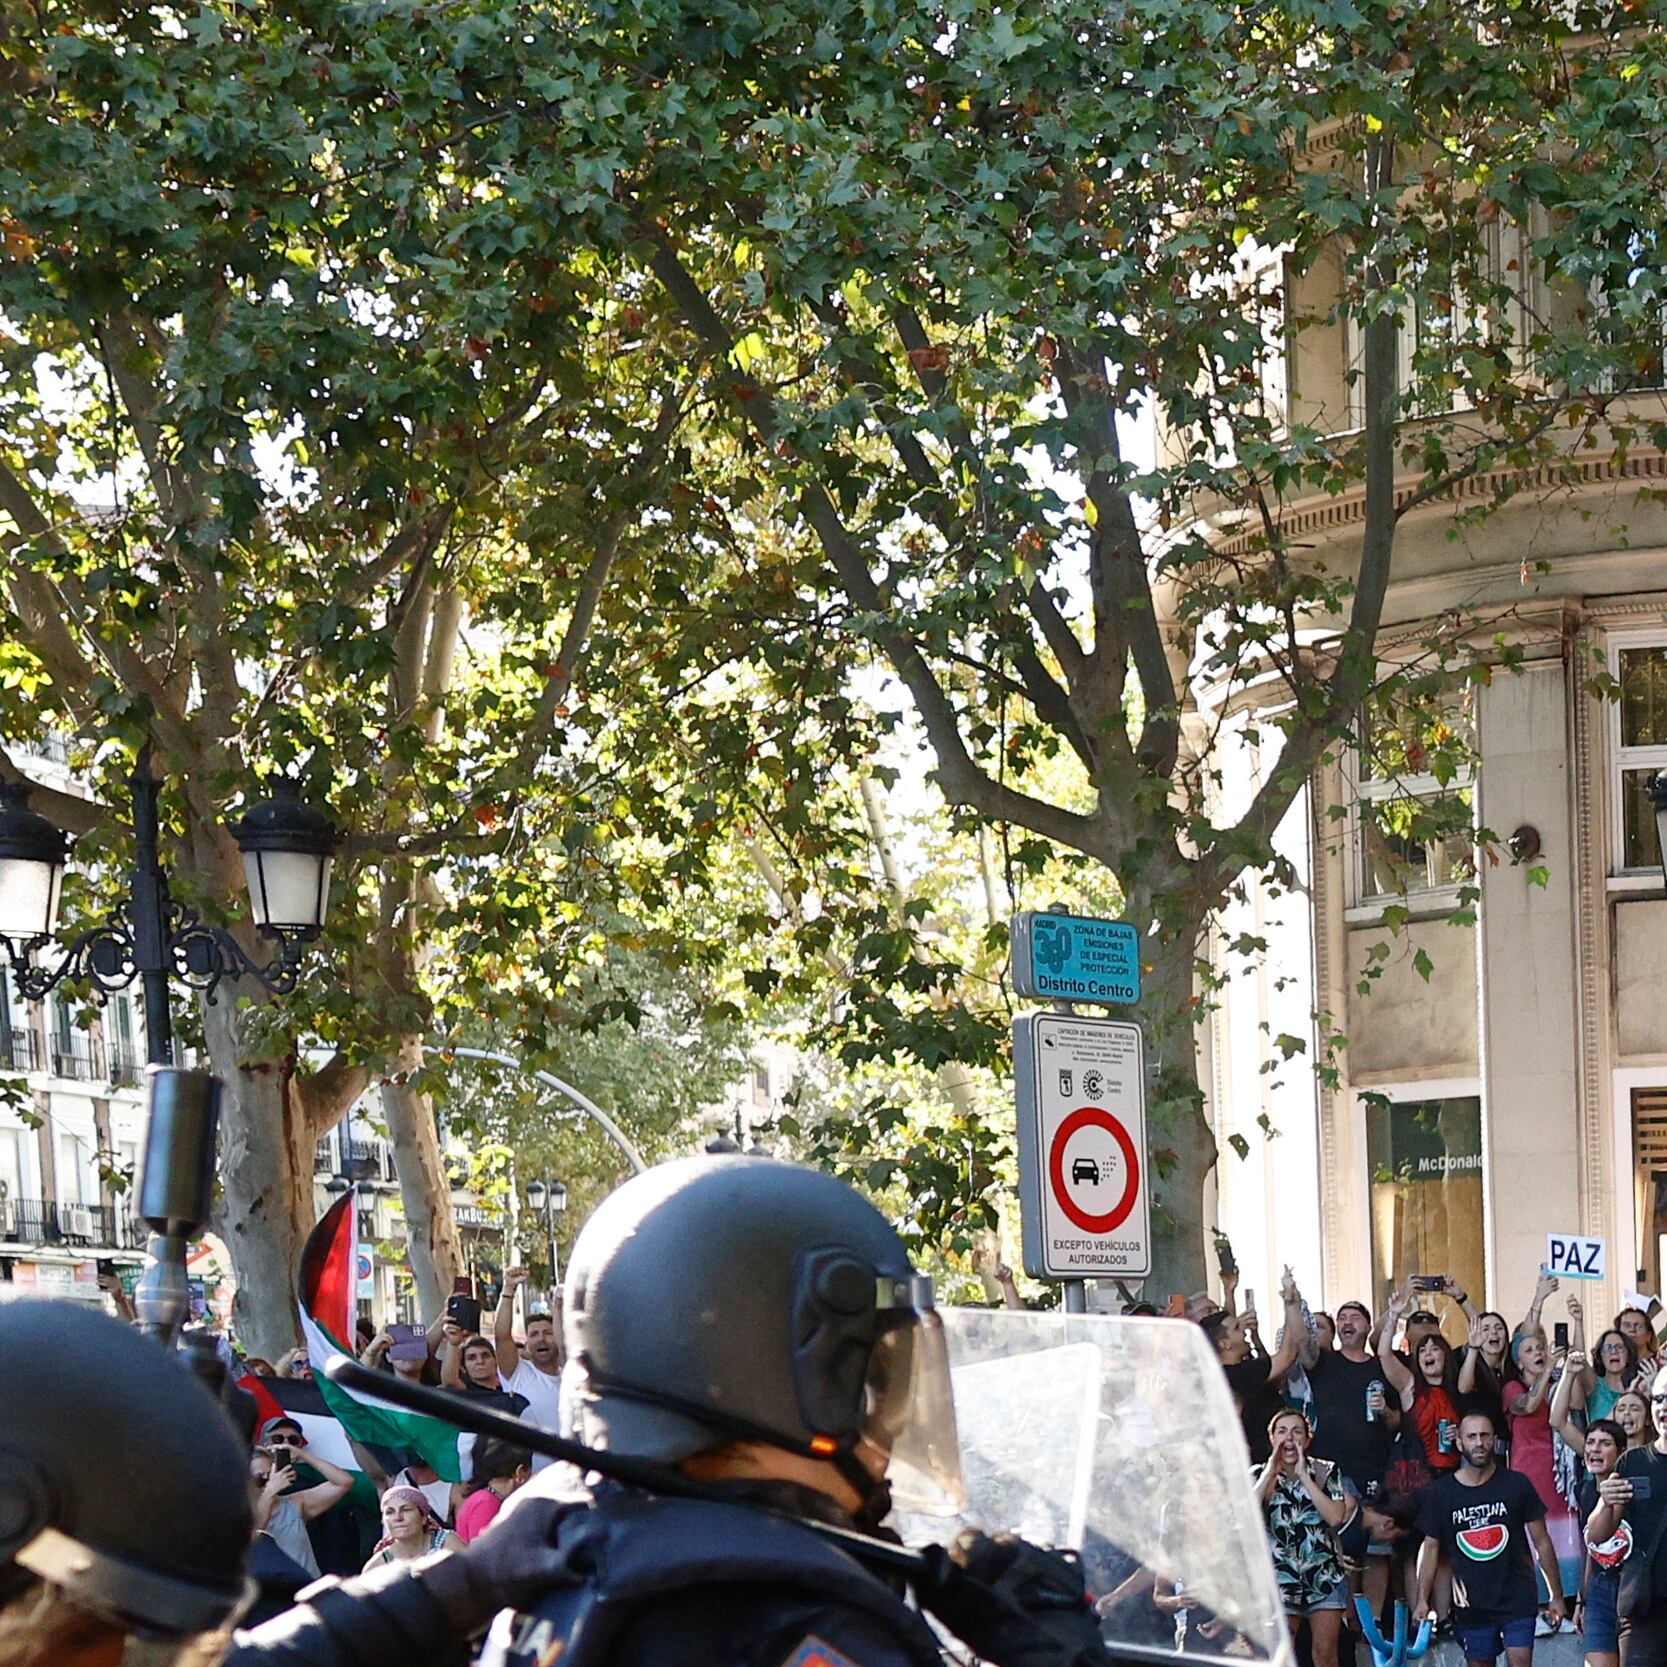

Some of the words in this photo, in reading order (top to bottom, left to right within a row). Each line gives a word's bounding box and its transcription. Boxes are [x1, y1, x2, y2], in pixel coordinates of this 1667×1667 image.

[1073, 925, 1095, 935] ZONA
[1096, 927, 1107, 937] DE
[1108, 928, 1133, 940] BAJAS
[1084, 938, 1124, 951] EMISIONES
[1080, 951, 1091, 960] DE
[1092, 951, 1128, 964] ESPECIAL
[1038, 975, 1085, 992] Distrito
[1088, 979, 1134, 998] Centro
[1053, 1239, 1092, 1250] EXCEPTO
[1094, 1239, 1141, 1251] VEHÍCULOS
[1068, 1254, 1127, 1265] AUTORIZADOS
[1551, 1239, 1601, 1275] PAZ
[1452, 1501, 1507, 1525] PALESTINA
